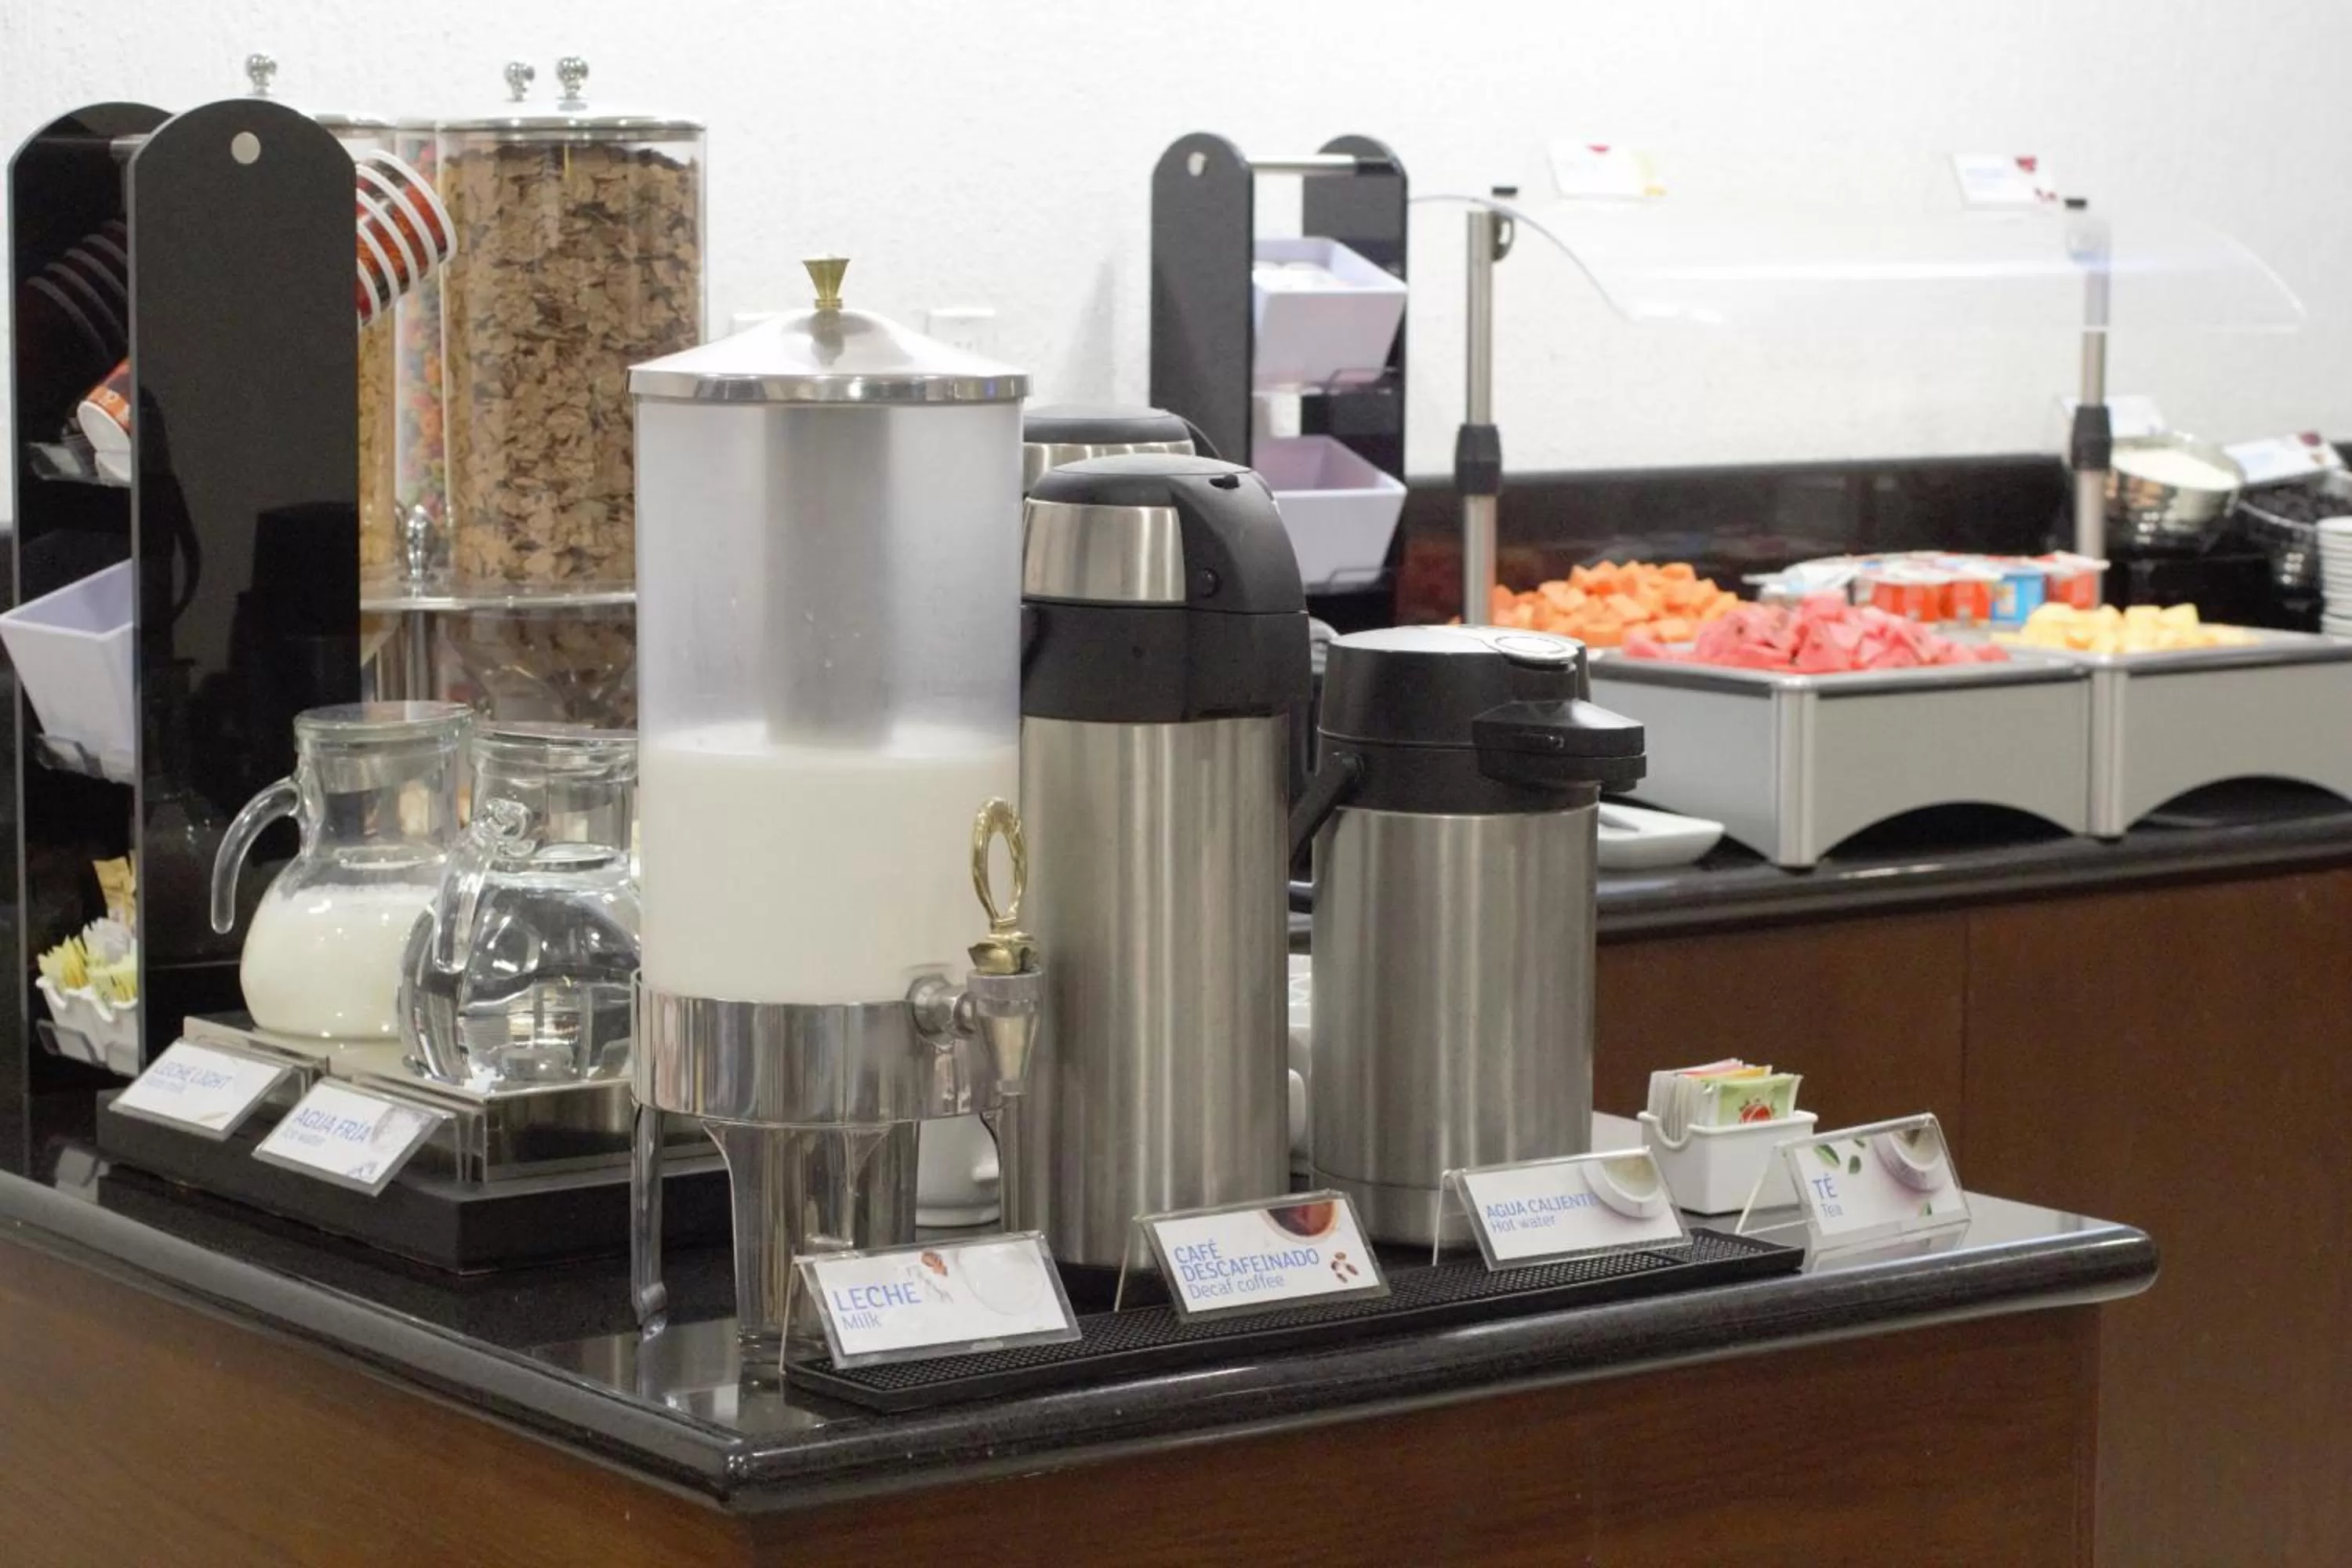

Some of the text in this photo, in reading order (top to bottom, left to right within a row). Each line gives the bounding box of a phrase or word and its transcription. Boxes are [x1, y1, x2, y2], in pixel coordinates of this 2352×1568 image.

[293, 1107, 337, 1133] AGUA
[1812, 1172, 1838, 1200] TÉ
[1486, 1200, 1527, 1218] AGUA
[1490, 1215, 1556, 1233] Hot water
[1173, 1238, 1222, 1265] CAFÉ
[1180, 1247, 1320, 1283] DESCAFEINADO
[831, 1281, 923, 1312] LECHE
[1187, 1272, 1285, 1300] Decaf coffee
[841, 1310, 882, 1330] Milk
